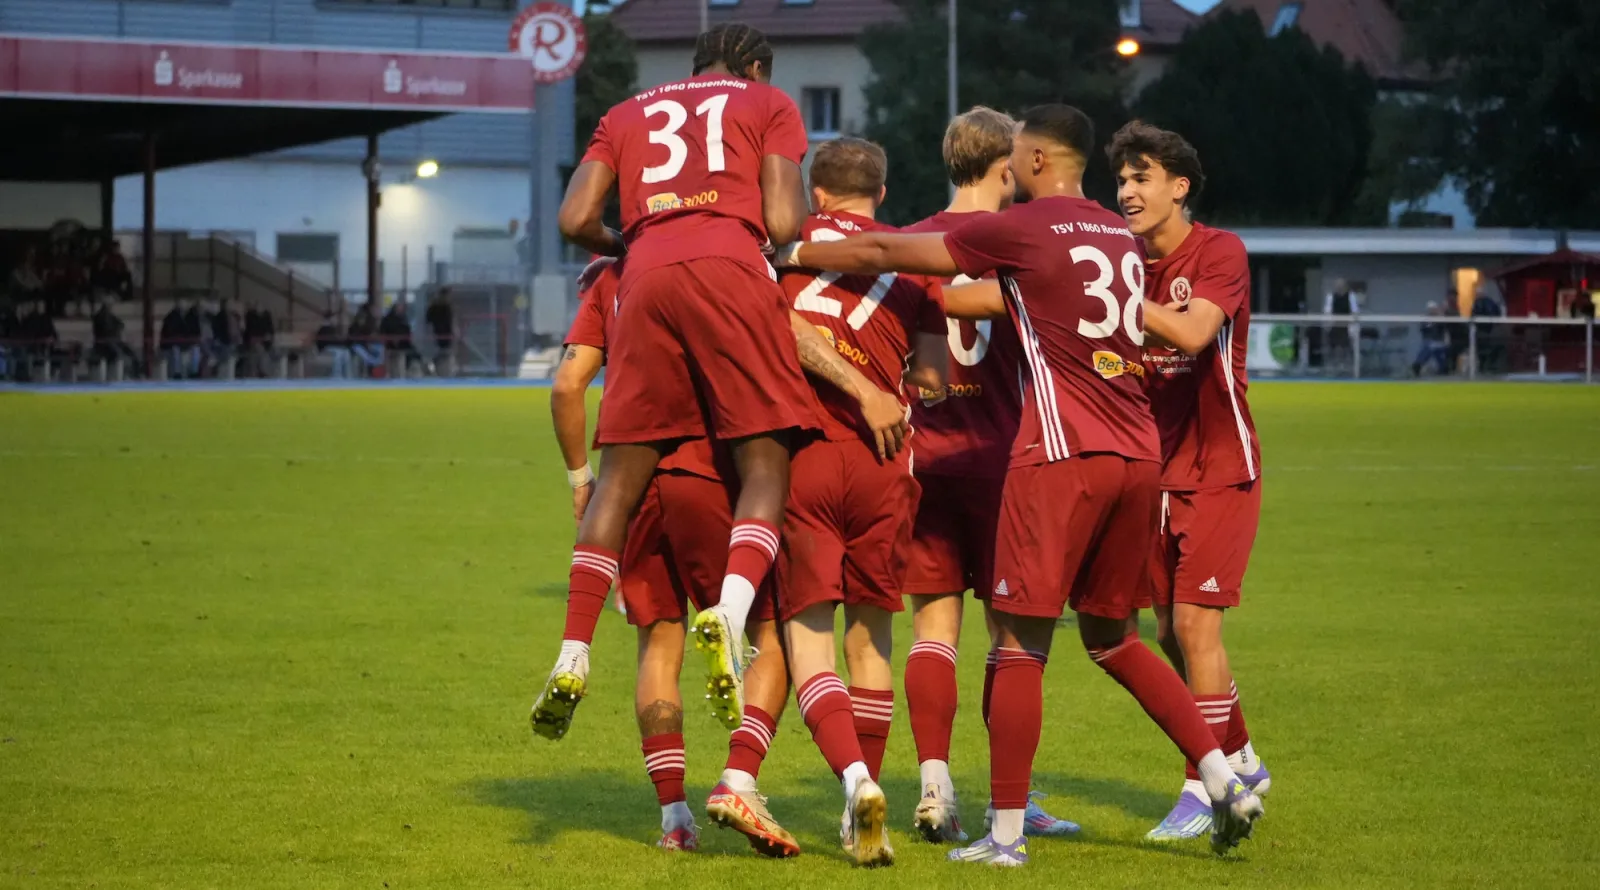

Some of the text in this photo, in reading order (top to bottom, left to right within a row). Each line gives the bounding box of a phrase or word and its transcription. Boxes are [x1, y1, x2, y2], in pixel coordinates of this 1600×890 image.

[178, 67, 243, 90] Sparkasse
[406, 76, 467, 97] Sparkasse
[635, 79, 747, 102] TSV 1860 Rosenheim
[641, 93, 729, 184] 31
[1050, 222, 1074, 235] TSV
[1076, 221, 1101, 234] 1860
[1068, 245, 1145, 347] 38
[836, 339, 869, 365] 3000
[1199, 585, 1220, 593] adidas
